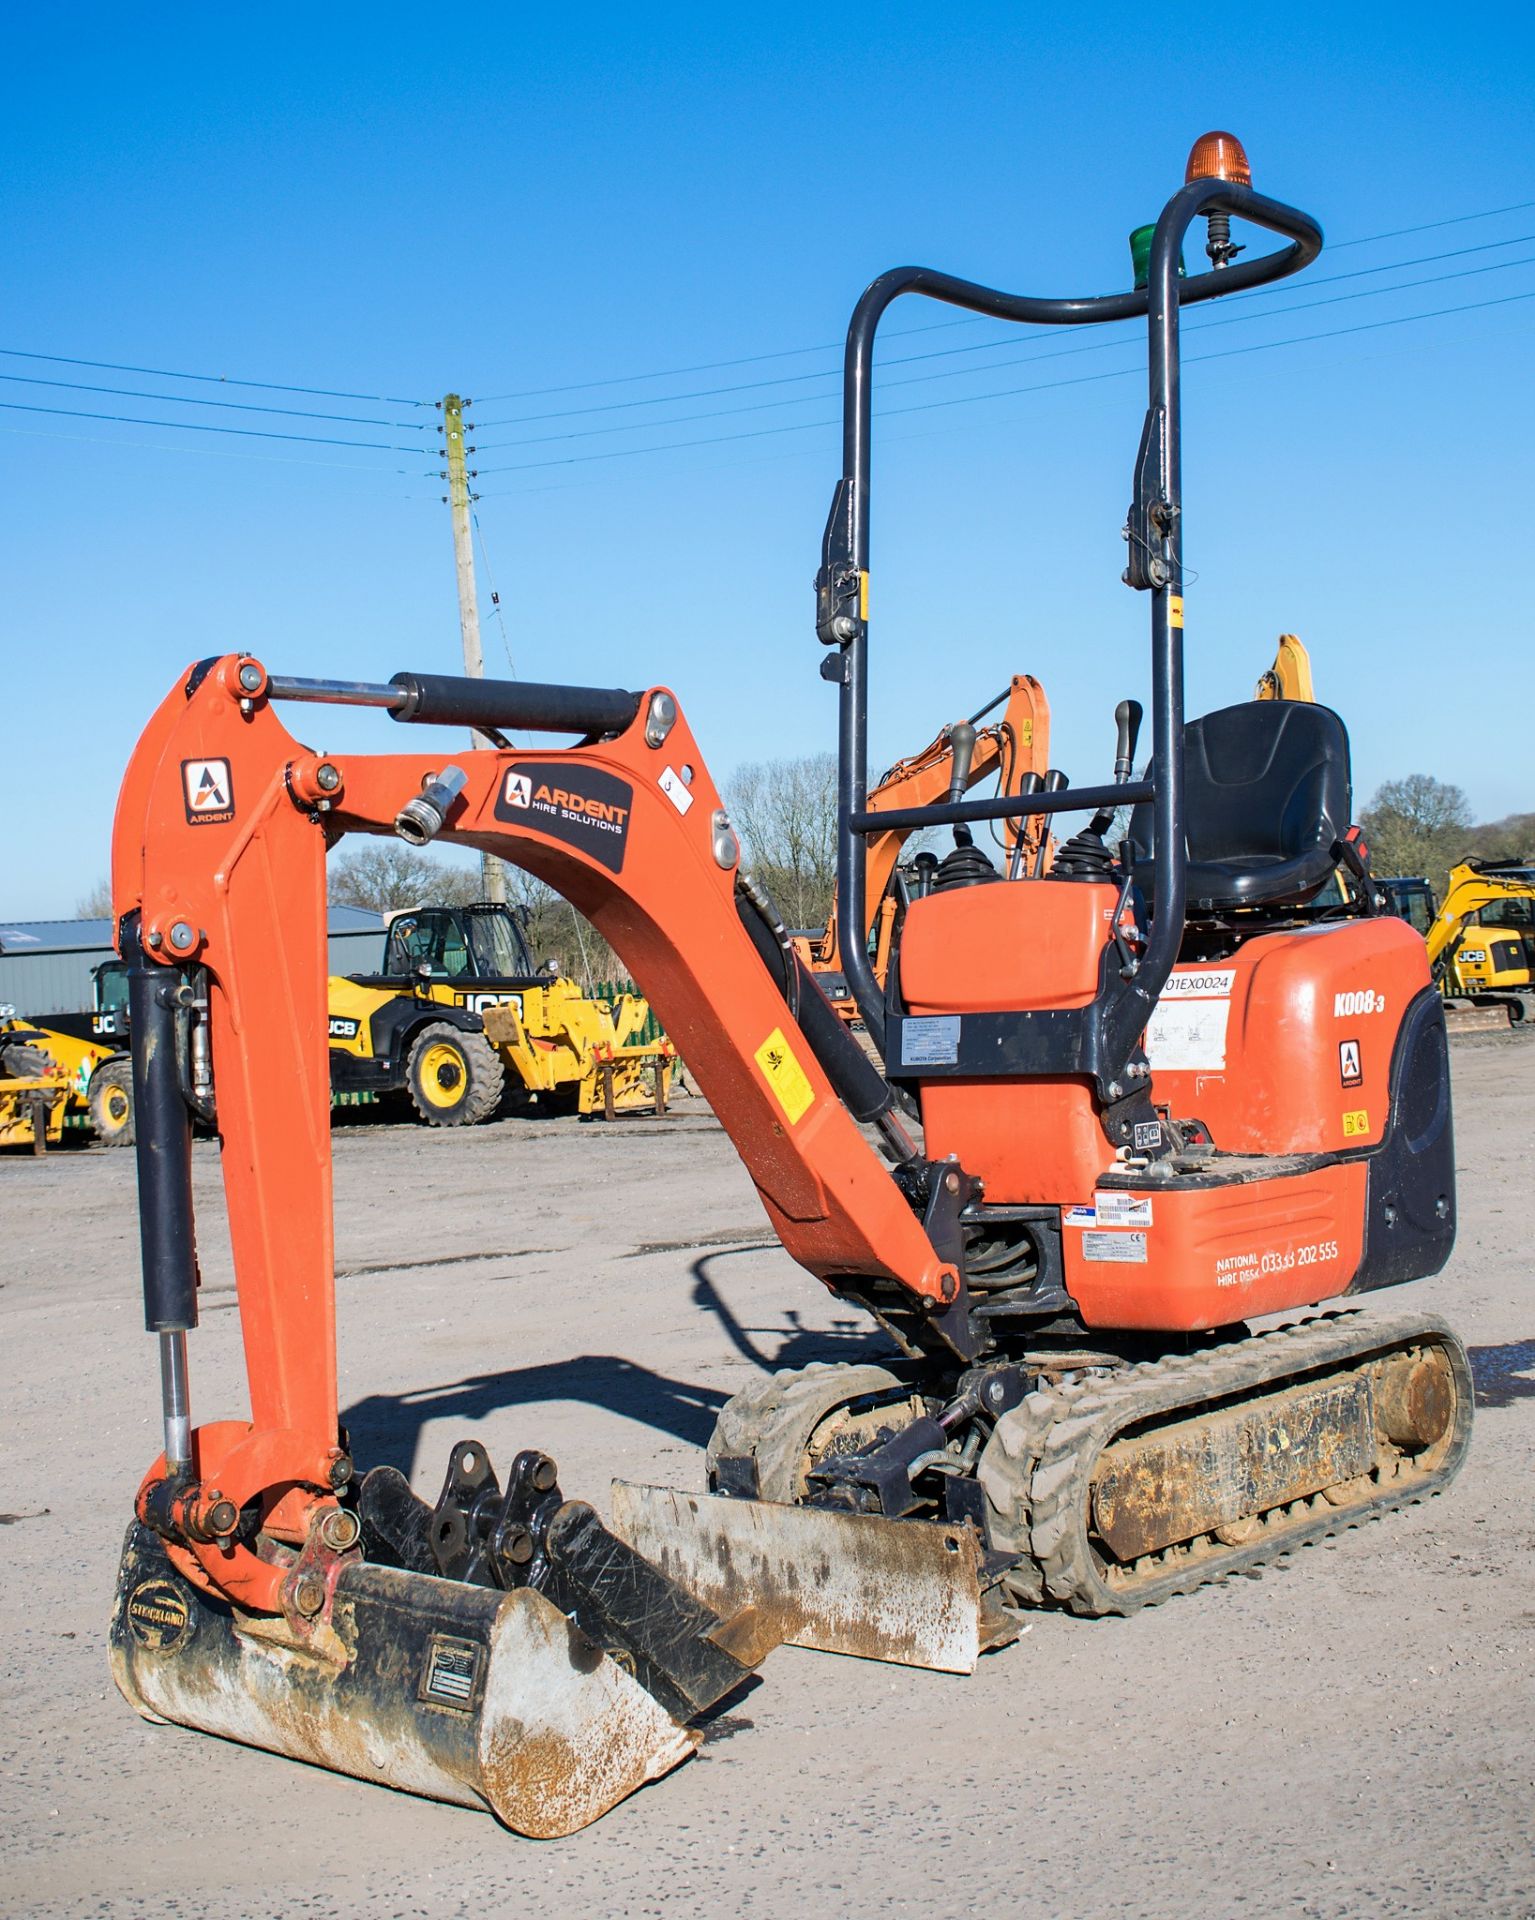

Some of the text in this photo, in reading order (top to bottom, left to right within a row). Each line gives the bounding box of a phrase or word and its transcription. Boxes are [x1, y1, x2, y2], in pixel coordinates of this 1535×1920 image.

[534, 785, 628, 824] ARDENT
[190, 813, 232, 823] ARDENT
[532, 801, 622, 834] HIRE SOLUTIONS
[1459, 951, 1486, 962] JCB
[1165, 977, 1228, 990] 01EX0024
[1334, 990, 1385, 1017] K008-3
[92, 1015, 116, 1034] JC
[1216, 1253, 1258, 1271] NATIONAL
[1261, 1241, 1338, 1273] 03333 202 555
[1217, 1273, 1238, 1286] HIRE
